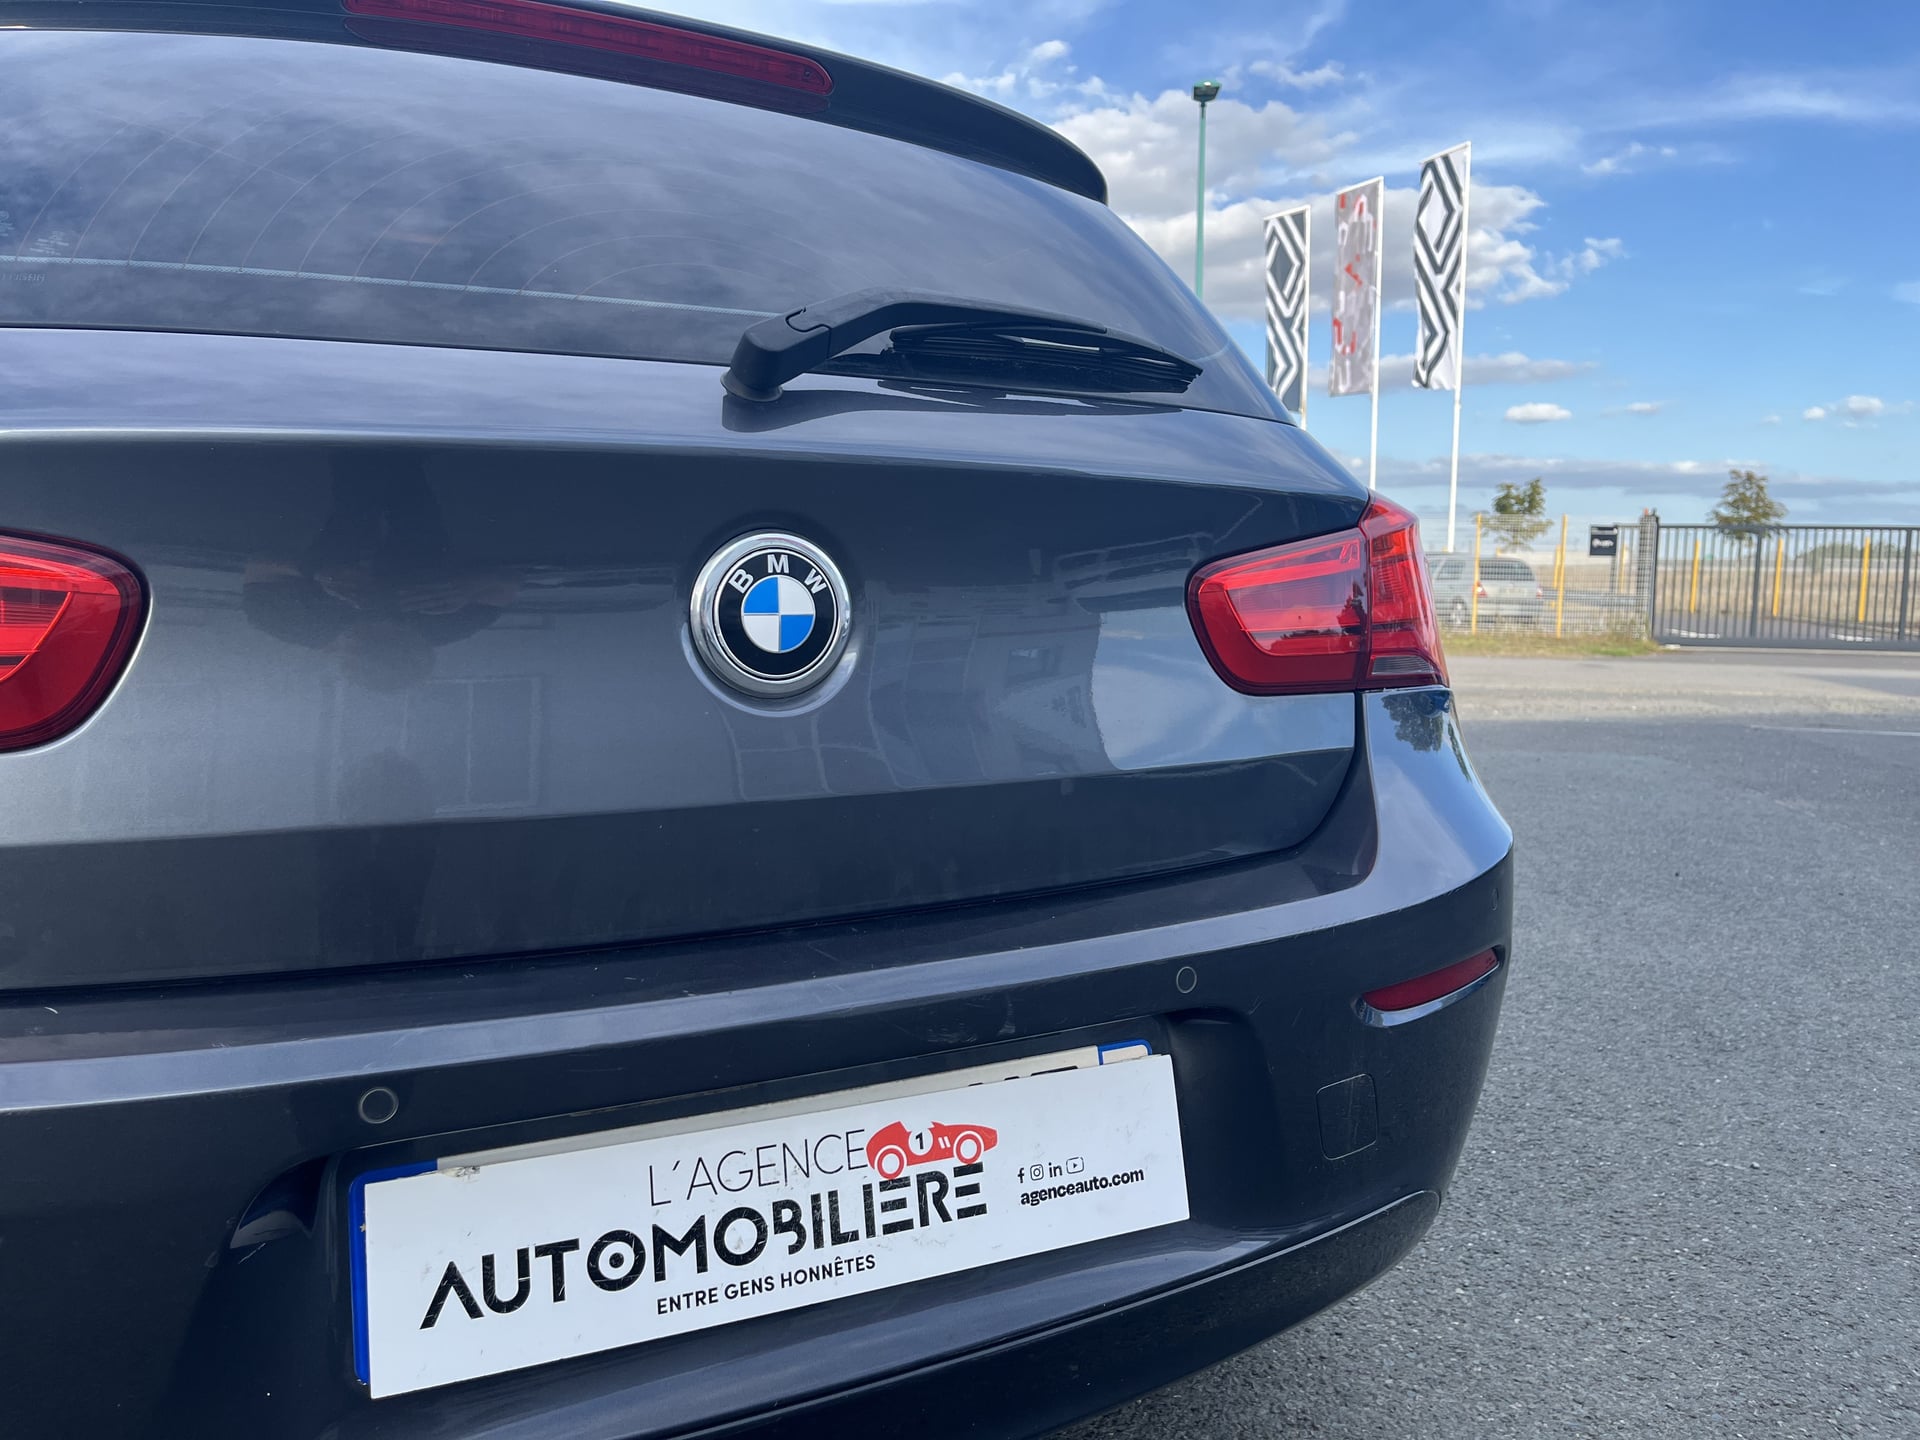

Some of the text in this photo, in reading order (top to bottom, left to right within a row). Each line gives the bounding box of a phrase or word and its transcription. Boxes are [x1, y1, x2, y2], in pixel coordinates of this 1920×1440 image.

[728, 554, 828, 594] BMW
[914, 1132, 926, 1150] 1
[649, 1129, 868, 1206] L'AGENCE
[1020, 1169, 1145, 1206] agenceauto.com
[657, 1254, 876, 1315] ENTRE GENS HONNÊTES
